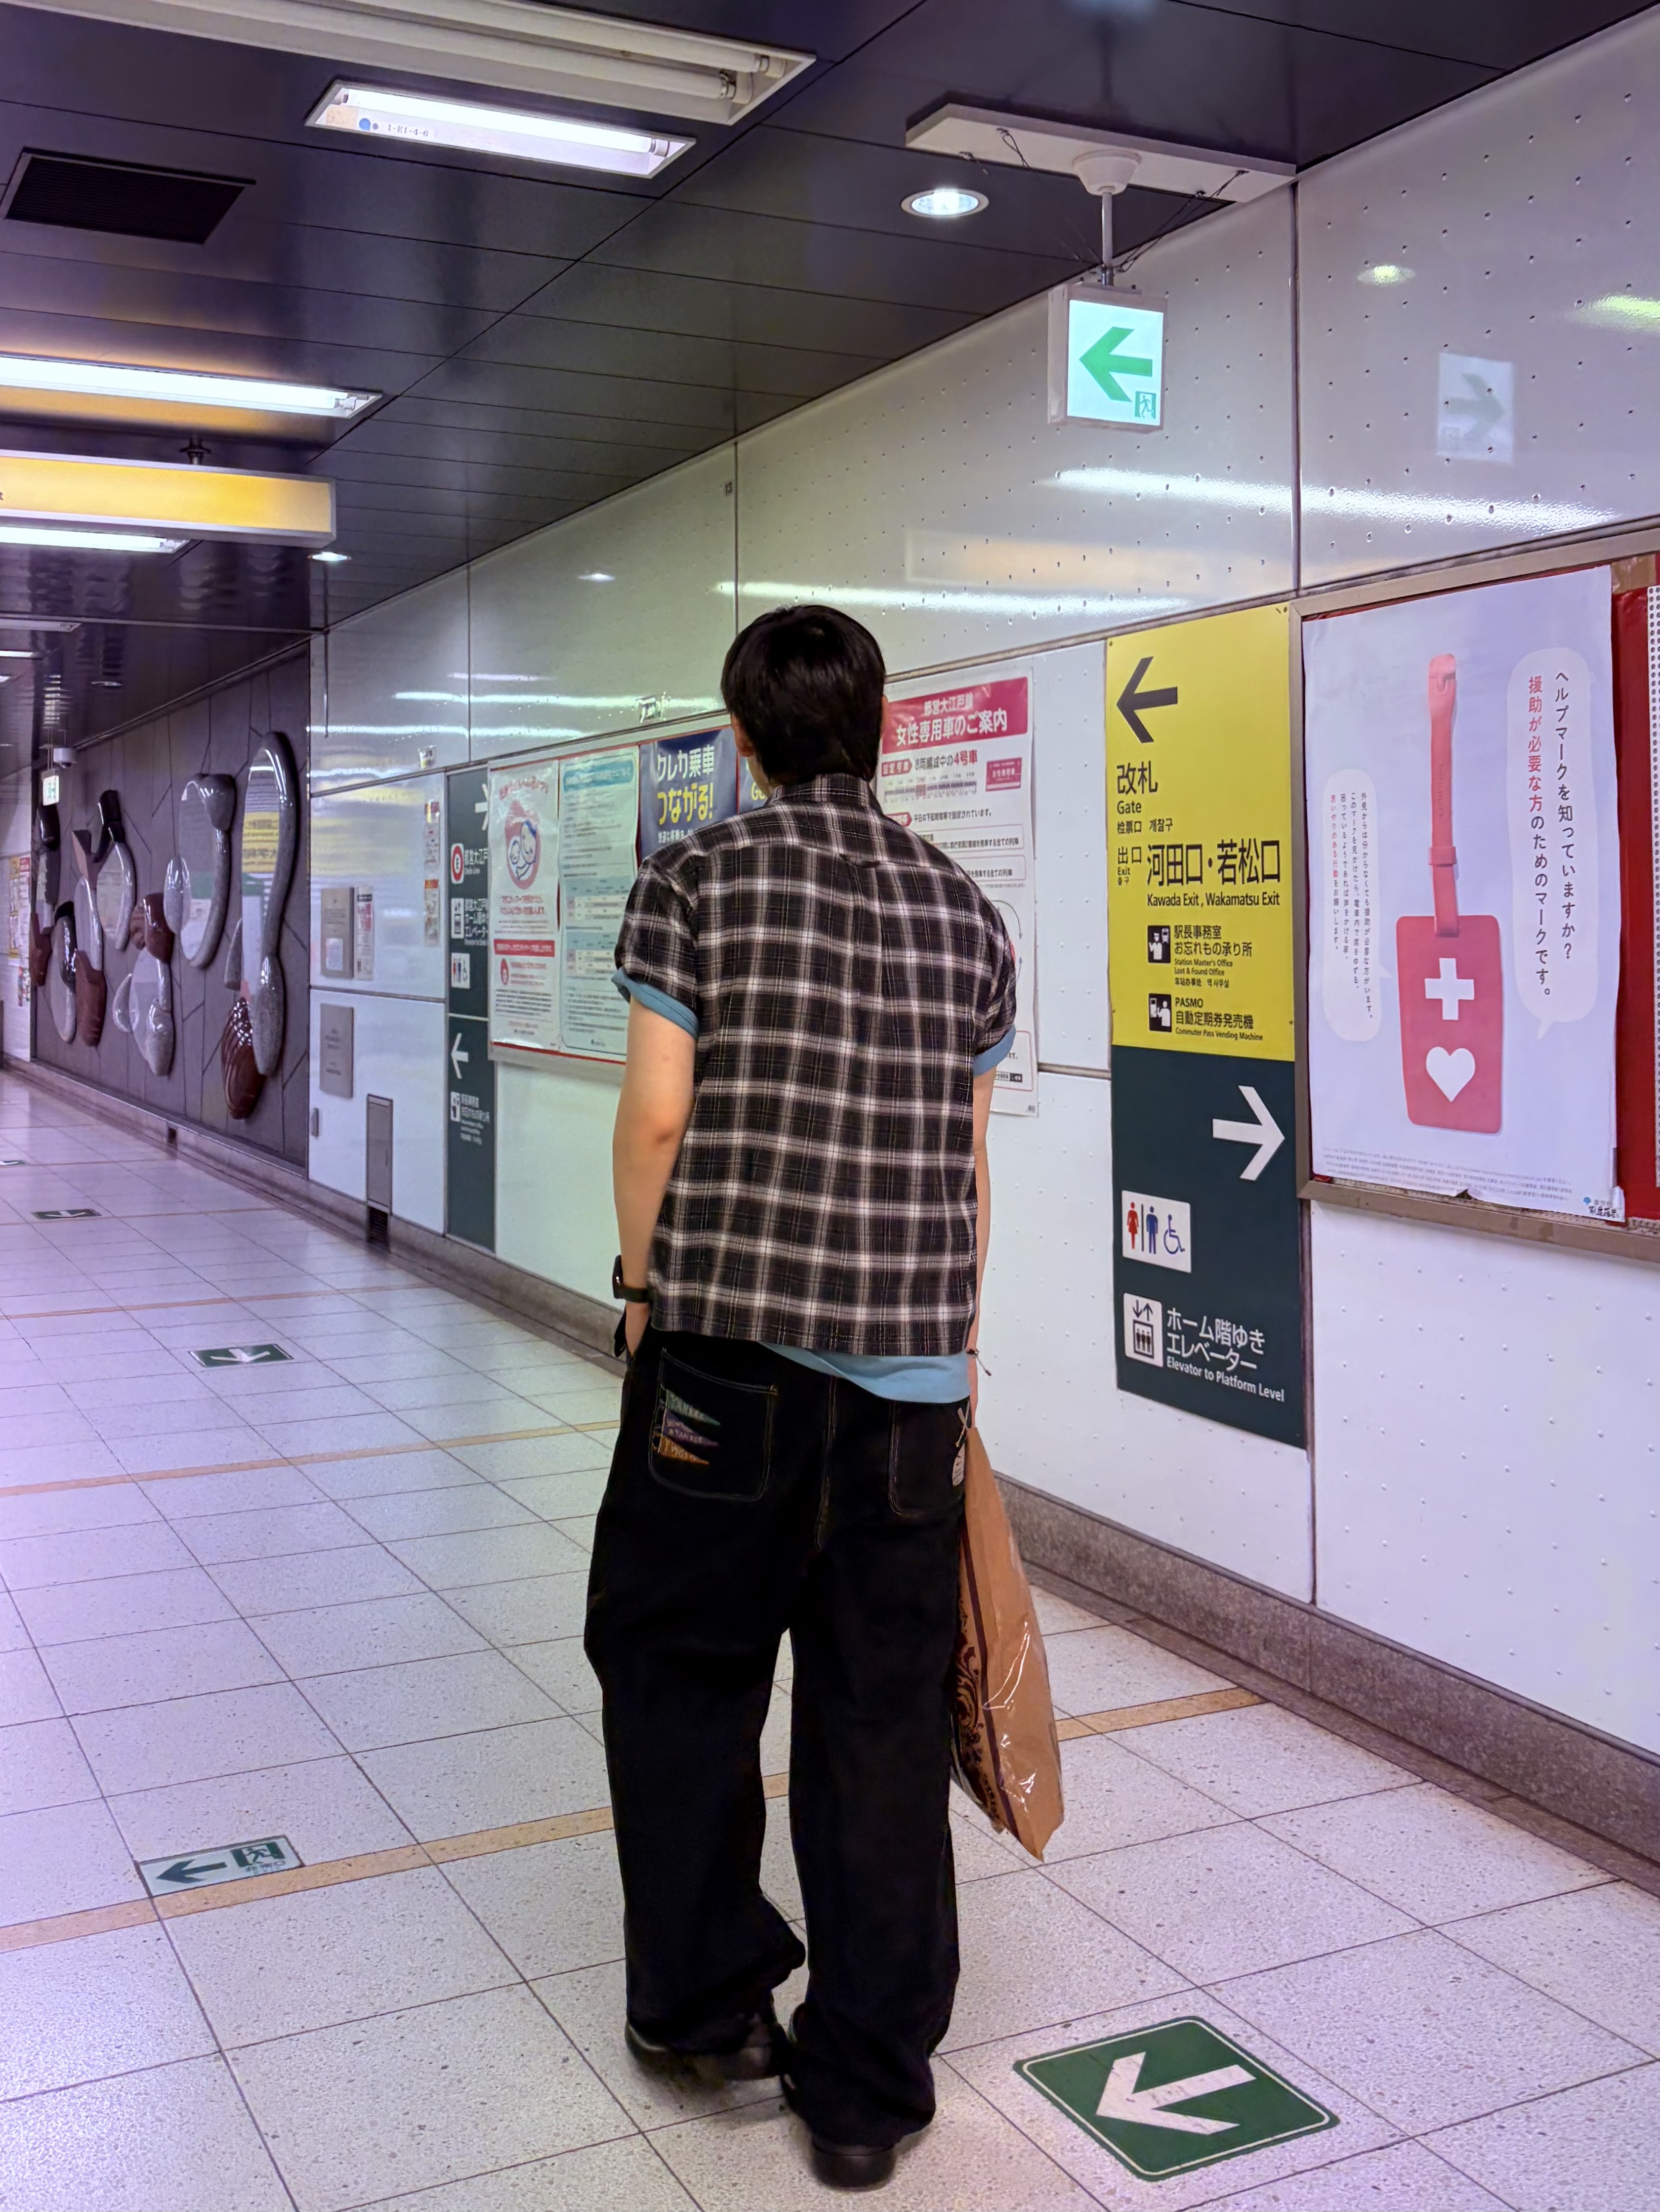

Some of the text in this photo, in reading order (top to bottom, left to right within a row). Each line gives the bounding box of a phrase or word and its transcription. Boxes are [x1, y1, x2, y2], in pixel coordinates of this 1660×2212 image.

[896, 707, 1008, 747] 女性専用車のご案内
[657, 744, 714, 783] クレカ乗車
[1117, 760, 1158, 795] 改札
[1117, 800, 1141, 814] Gate
[1555, 671, 1576, 960] ヘルプマークを知っていますか？
[1527, 676, 1550, 996] 援助が必要な方のためのマークです。
[1117, 846, 1142, 865] 出口
[1147, 838, 1280, 886] 河田口・若松口
[1117, 867, 1131, 876] Exit
[1147, 892, 1181, 907] Kawada
[1206, 891, 1259, 906] Wakamatsu
[1262, 890, 1280, 906] Exit
[1174, 925, 1221, 940] 駅長事務室
[1174, 941, 1253, 957] お忘れもの承り所
[1191, 967, 1208, 975] Found
[1209, 968, 1225, 976] Office
[1175, 997, 1204, 1008] PASMO
[1176, 1010, 1254, 1030] 自動定期券発売機
[1175, 1027, 1202, 1036] Commuter
[1215, 1030, 1238, 1041] Vending
[1239, 1032, 1263, 1041] Machine
[1167, 1307, 1265, 1355] ホーム階ゆき
[1167, 1332, 1258, 1372] エレベーター
[1167, 1355, 1284, 1402] Elevator to Platform Level
